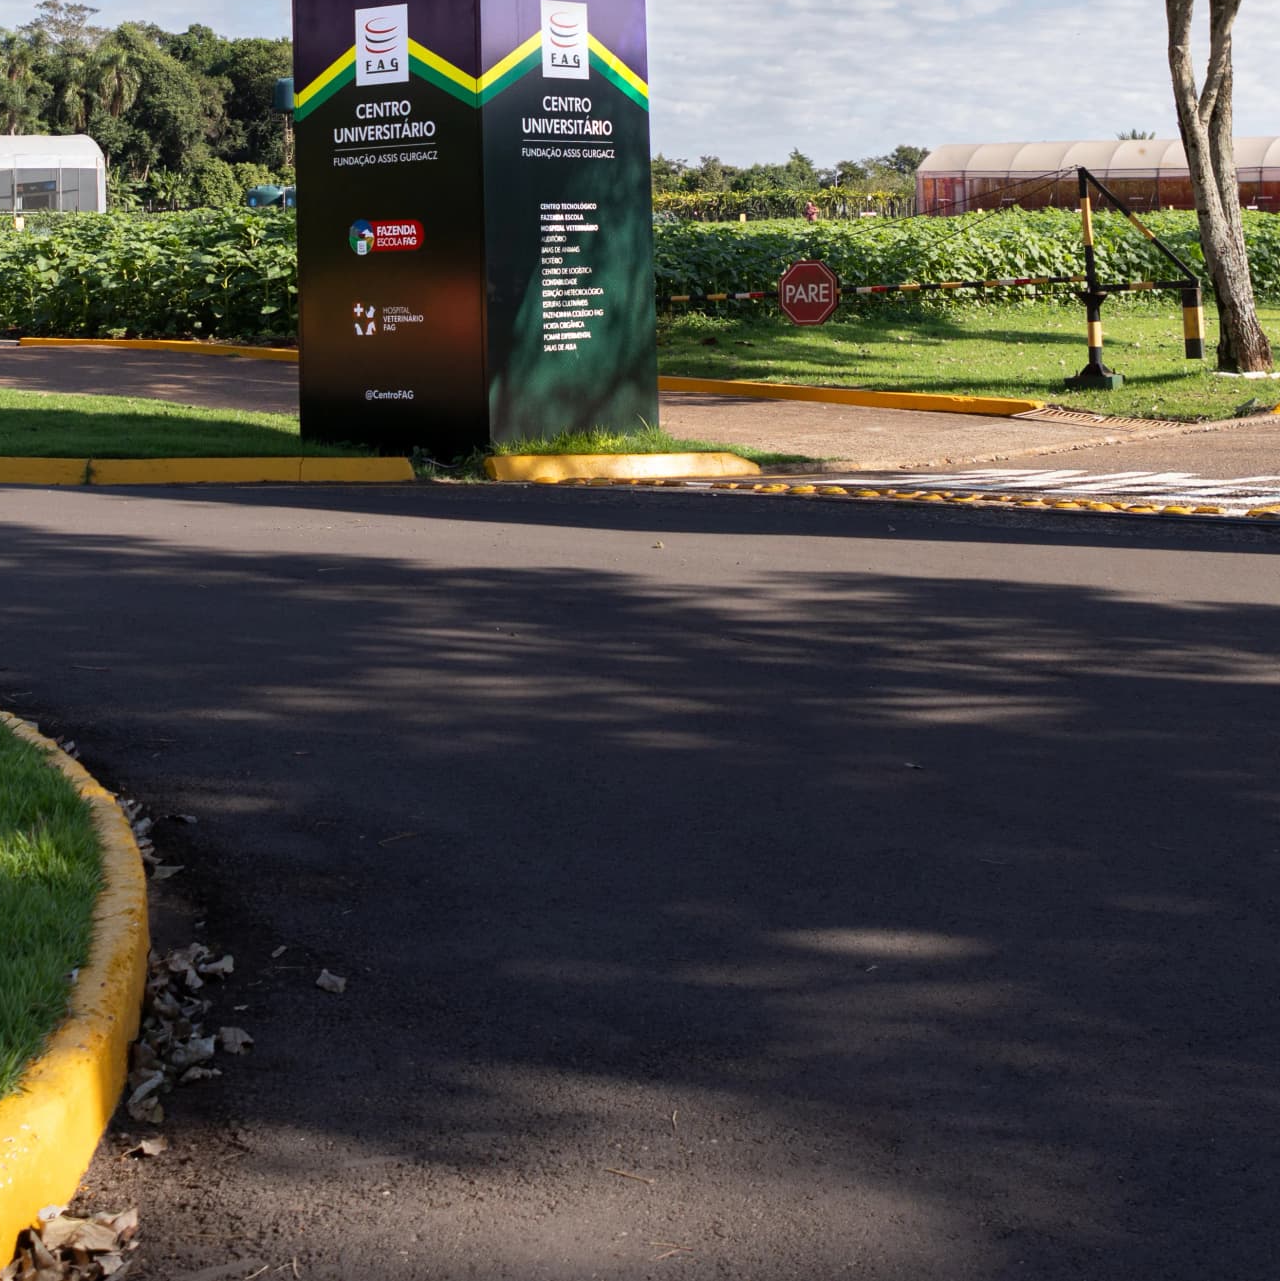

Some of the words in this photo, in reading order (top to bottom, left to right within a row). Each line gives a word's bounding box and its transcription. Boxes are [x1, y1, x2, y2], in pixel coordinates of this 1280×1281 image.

[365, 57, 399, 73] FAG
[551, 53, 580, 68] FAG
[356, 100, 412, 119] CENTRO
[542, 95, 592, 113] CENTRO
[333, 117, 436, 144] UNIVERSITÁRIO
[521, 115, 613, 136] UNIVERSITÁRIO
[333, 153, 376, 167] FUNDAÇÃO
[378, 153, 398, 163] ASSIS
[400, 150, 438, 162] GURGACZ
[521, 146, 562, 160] FUNDAÇÃO
[563, 148, 581, 158] ASSIS
[582, 148, 615, 159] GURGACZ
[376, 224, 417, 236] FAZENDA
[377, 237, 402, 247] ESCOLA
[403, 236, 417, 246] FAG
[785, 283, 830, 304] PARE
[382, 306, 410, 314] HOSPITAL
[383, 313, 424, 323] VETERINÁRIO
[383, 323, 396, 331] FAG
[365, 389, 415, 401] @CentroFAG
